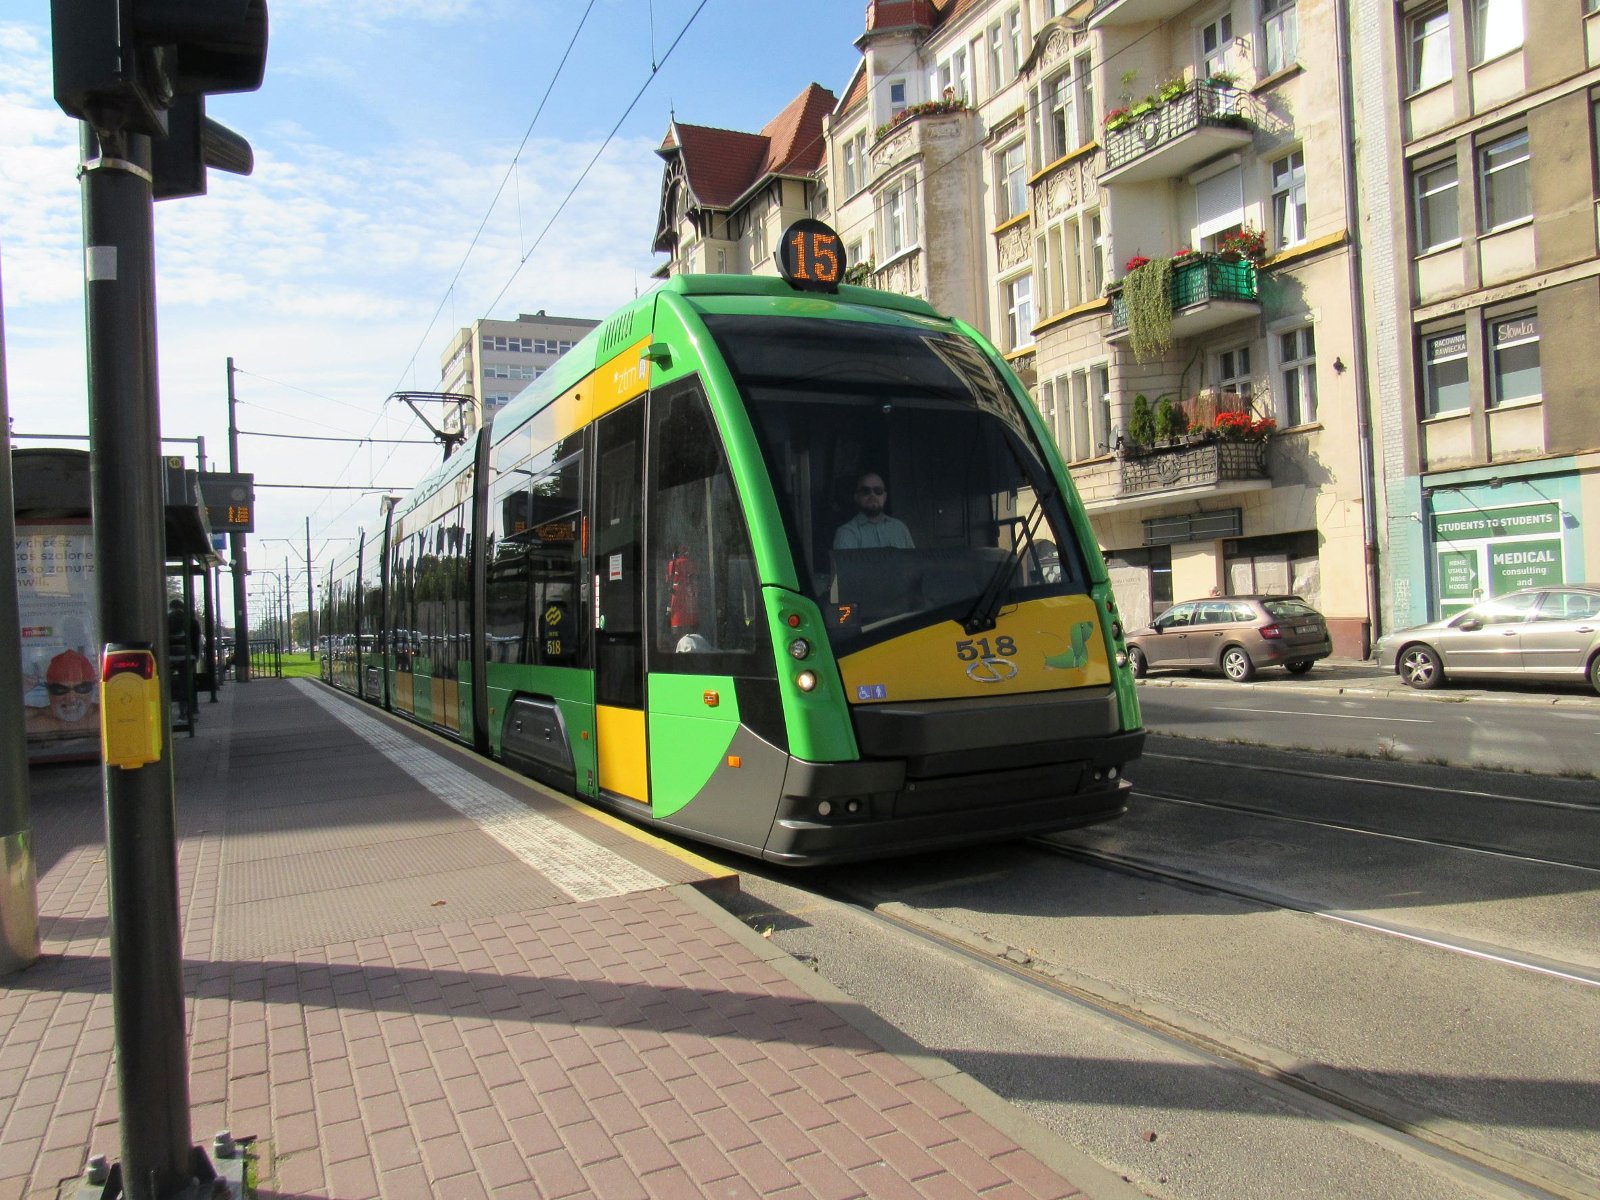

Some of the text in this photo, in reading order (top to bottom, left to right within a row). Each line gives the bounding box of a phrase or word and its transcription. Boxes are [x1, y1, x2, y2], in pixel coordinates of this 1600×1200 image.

[791, 231, 838, 282] 15
[1437, 513, 1553, 533] STUDENTS TO STUDENTS
[1493, 551, 1555, 565] MEDICAL
[1502, 566, 1547, 578] consulting
[1516, 578, 1533, 586] and
[838, 605, 851, 624] 7
[547, 640, 561, 655] 518
[956, 635, 1017, 661] 518
